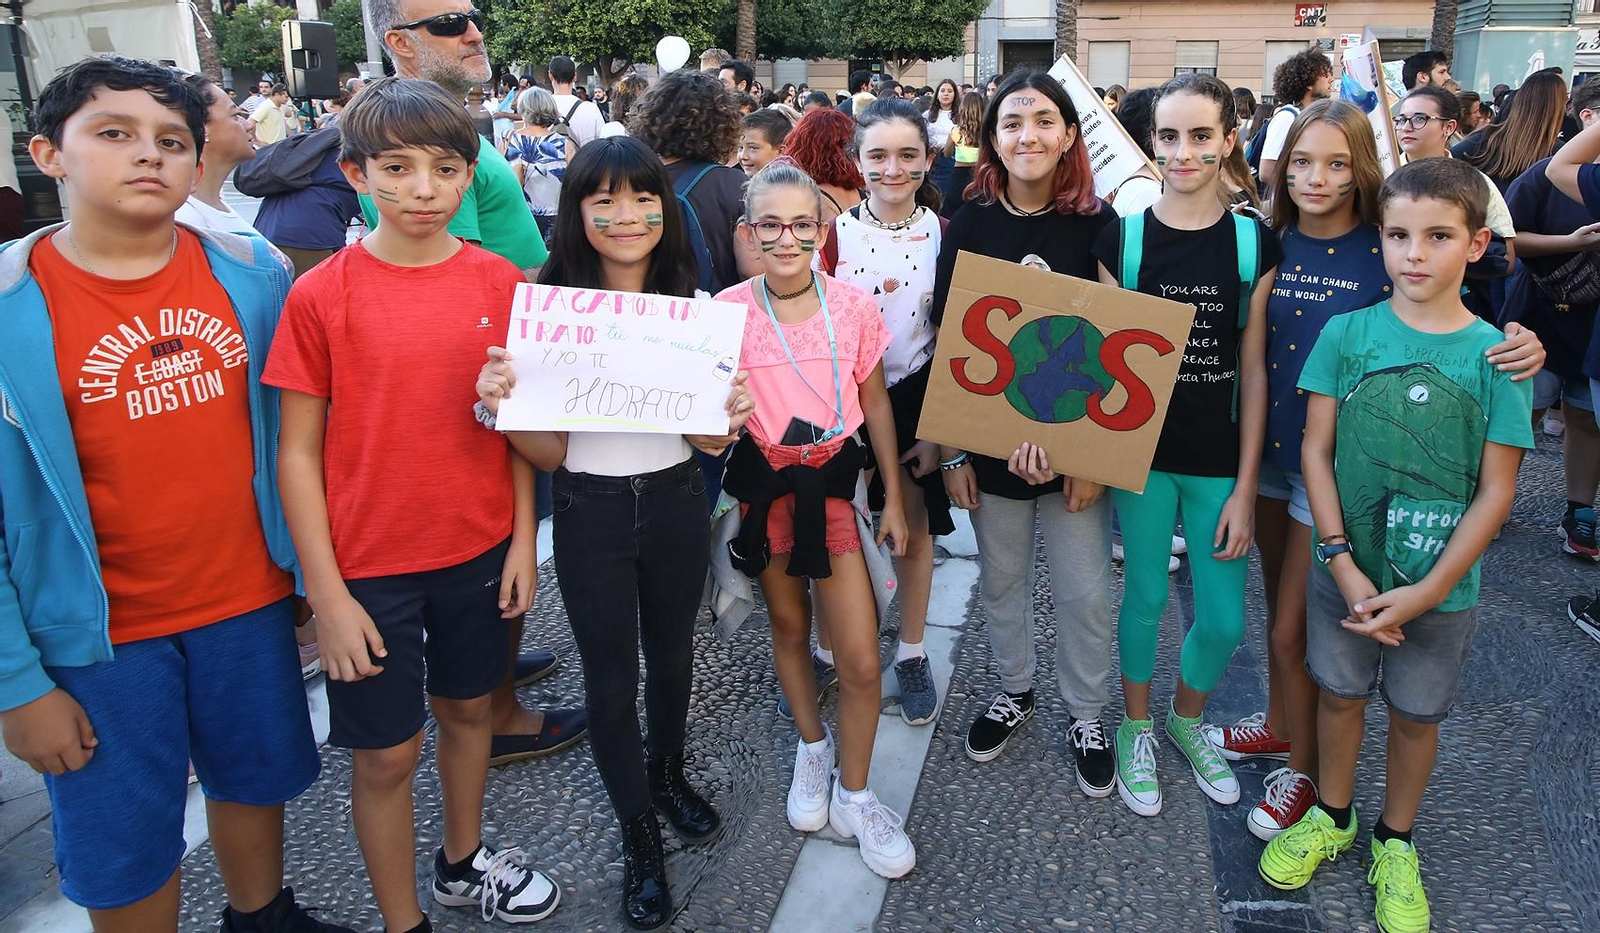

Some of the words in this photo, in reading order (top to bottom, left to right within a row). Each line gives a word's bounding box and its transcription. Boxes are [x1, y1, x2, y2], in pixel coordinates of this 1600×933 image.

[1300, 7, 1323, 17] CNT
[1011, 97, 1036, 107] STOP
[1282, 272, 1297, 282] YOU
[1300, 274, 1319, 284] CAN
[1322, 277, 1360, 291] CHANGE
[1160, 283, 1189, 297] YOU
[1190, 285, 1219, 295] ARE
[1275, 288, 1292, 298] THE
[1295, 290, 1326, 302] WORLD
[669, 300, 700, 321] UN
[1199, 302, 1224, 312] TOO
[515, 318, 598, 345] TRATO:
[78, 315, 155, 404] CENTRAL
[159, 307, 249, 369] DISTRICTS
[154, 342, 180, 356] 1989
[134, 349, 204, 385] E.COAST
[589, 353, 609, 369] TE
[950, 295, 1175, 431] SOS
[1183, 354, 1220, 365] RENCE
[1177, 372, 1199, 383] reta
[126, 369, 225, 420] BOSTON
[564, 376, 697, 421] HIDRATO
